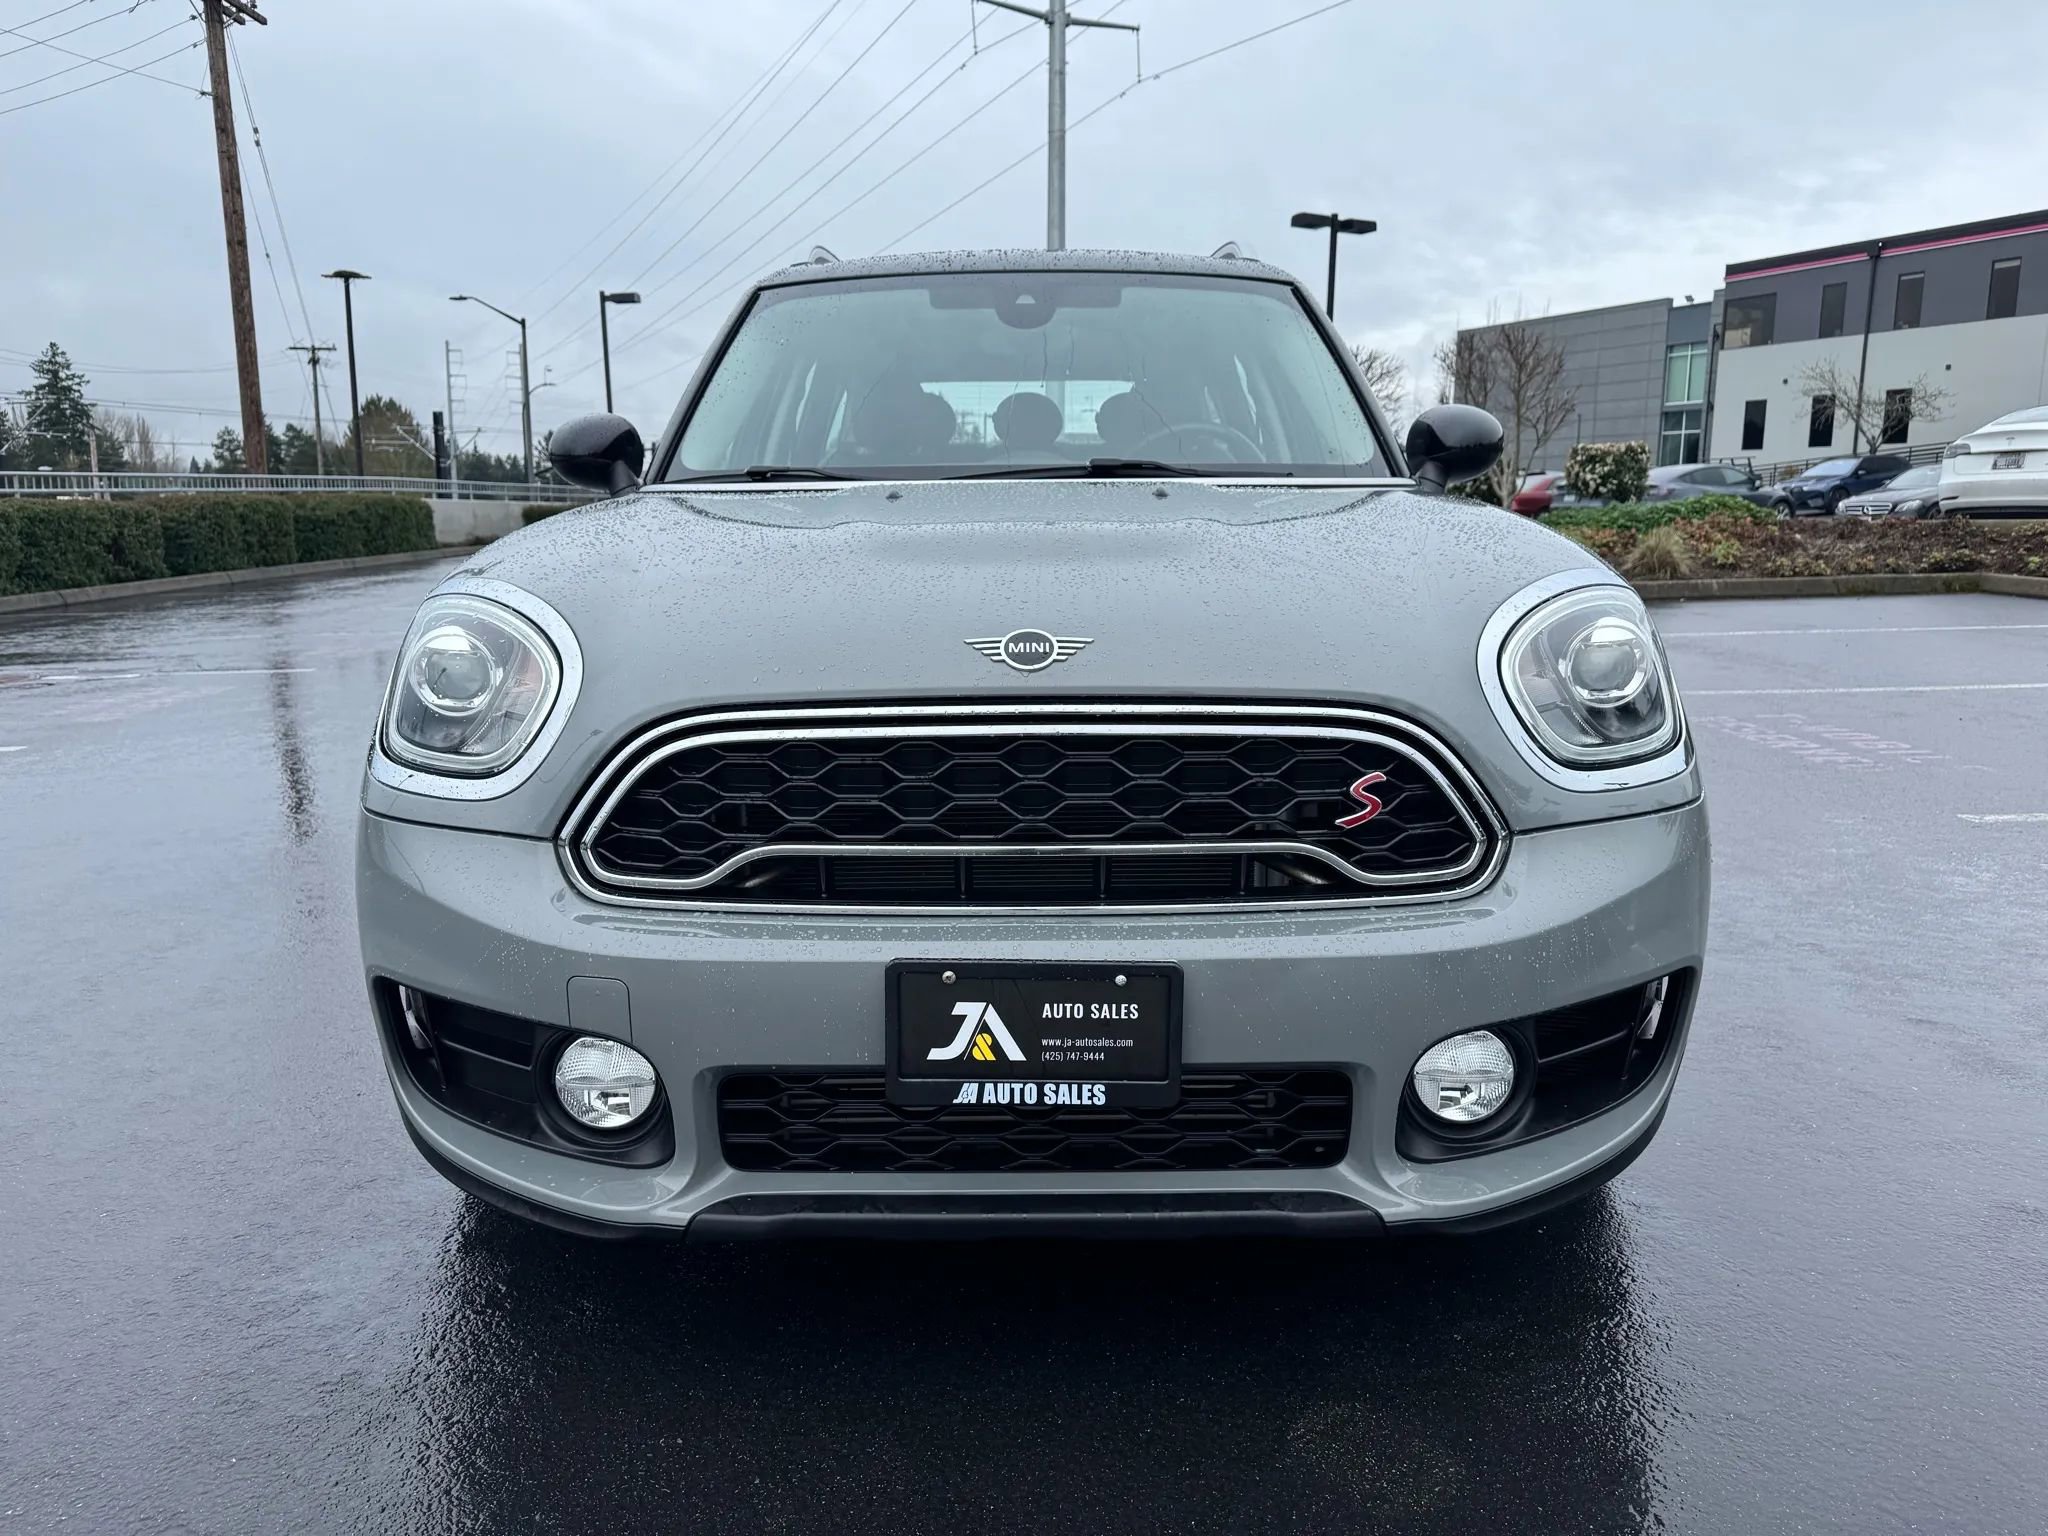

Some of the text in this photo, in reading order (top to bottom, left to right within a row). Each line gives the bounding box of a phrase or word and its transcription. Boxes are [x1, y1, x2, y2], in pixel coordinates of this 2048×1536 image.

[1008, 642, 1050, 653] MINI
[1335, 771, 1387, 829] S
[1042, 1003, 1139, 1019] AUTO SALES
[1041, 1037, 1134, 1048] www.ja-autosales.com
[1041, 1051, 1105, 1062] (425) 747-9444
[982, 1082, 1038, 1105] AUTO
[1043, 1083, 1106, 1106] SALES
